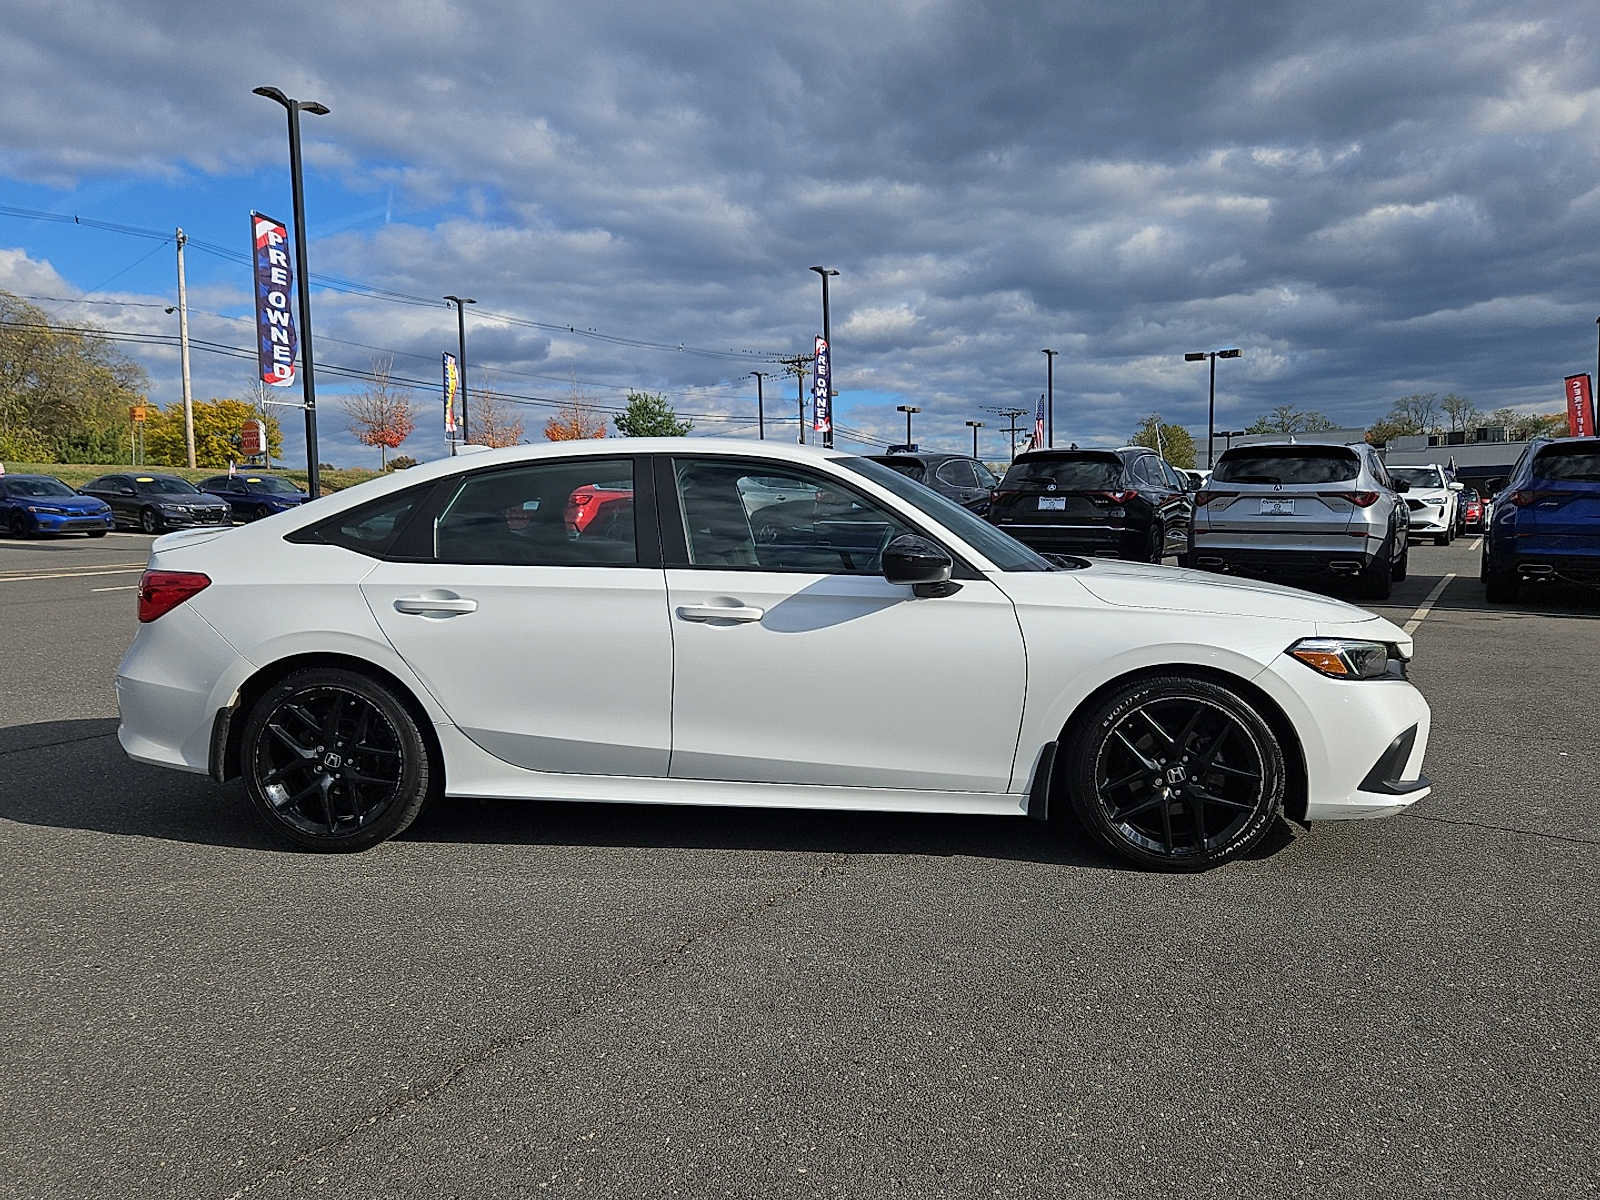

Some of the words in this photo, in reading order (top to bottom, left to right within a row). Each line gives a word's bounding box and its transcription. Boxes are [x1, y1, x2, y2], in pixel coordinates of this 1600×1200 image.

[268, 231, 288, 286] PRE
[266, 291, 292, 379] OWNED
[817, 345, 827, 375] PRE
[816, 378, 827, 427] OWNED
